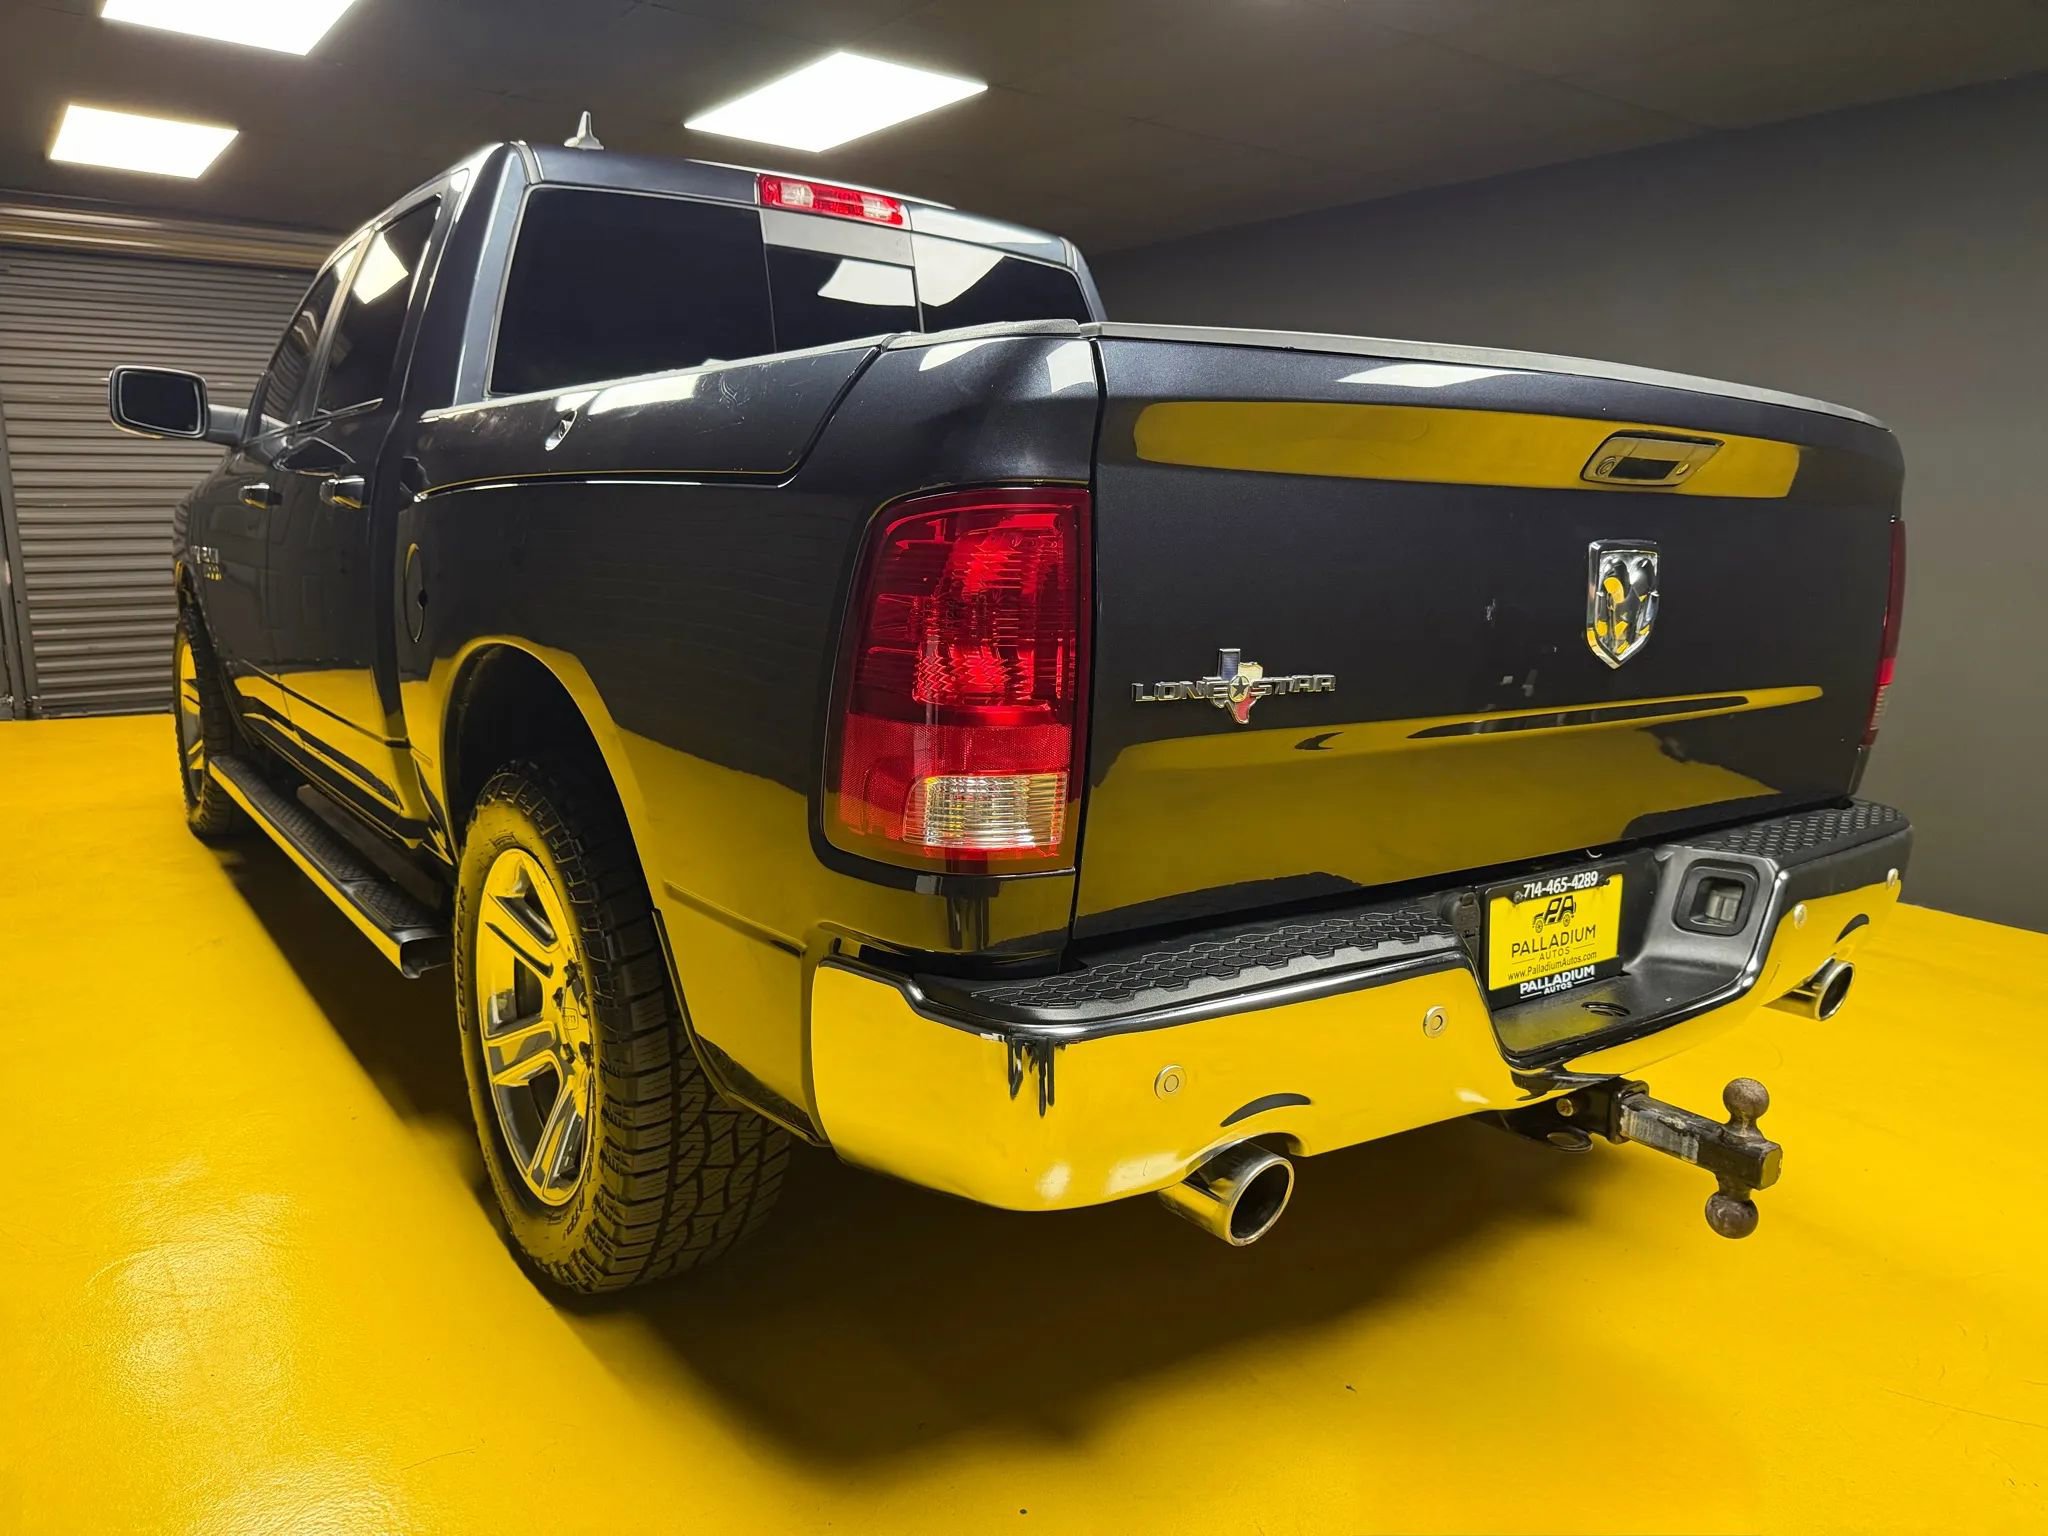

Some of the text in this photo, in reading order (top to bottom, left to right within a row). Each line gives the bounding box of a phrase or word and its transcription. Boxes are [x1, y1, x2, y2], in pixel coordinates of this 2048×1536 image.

[1132, 674, 1337, 701] LONE STAR
[1523, 871, 1599, 898] 714-465-4289
[1511, 924, 1596, 958] PALLADIUM
[1538, 946, 1570, 962] AUTOS
[1507, 951, 1597, 981] www.PalladiumAutos.com
[1519, 965, 1596, 994] PALLADIUM
[1543, 981, 1573, 995] AUTOS
